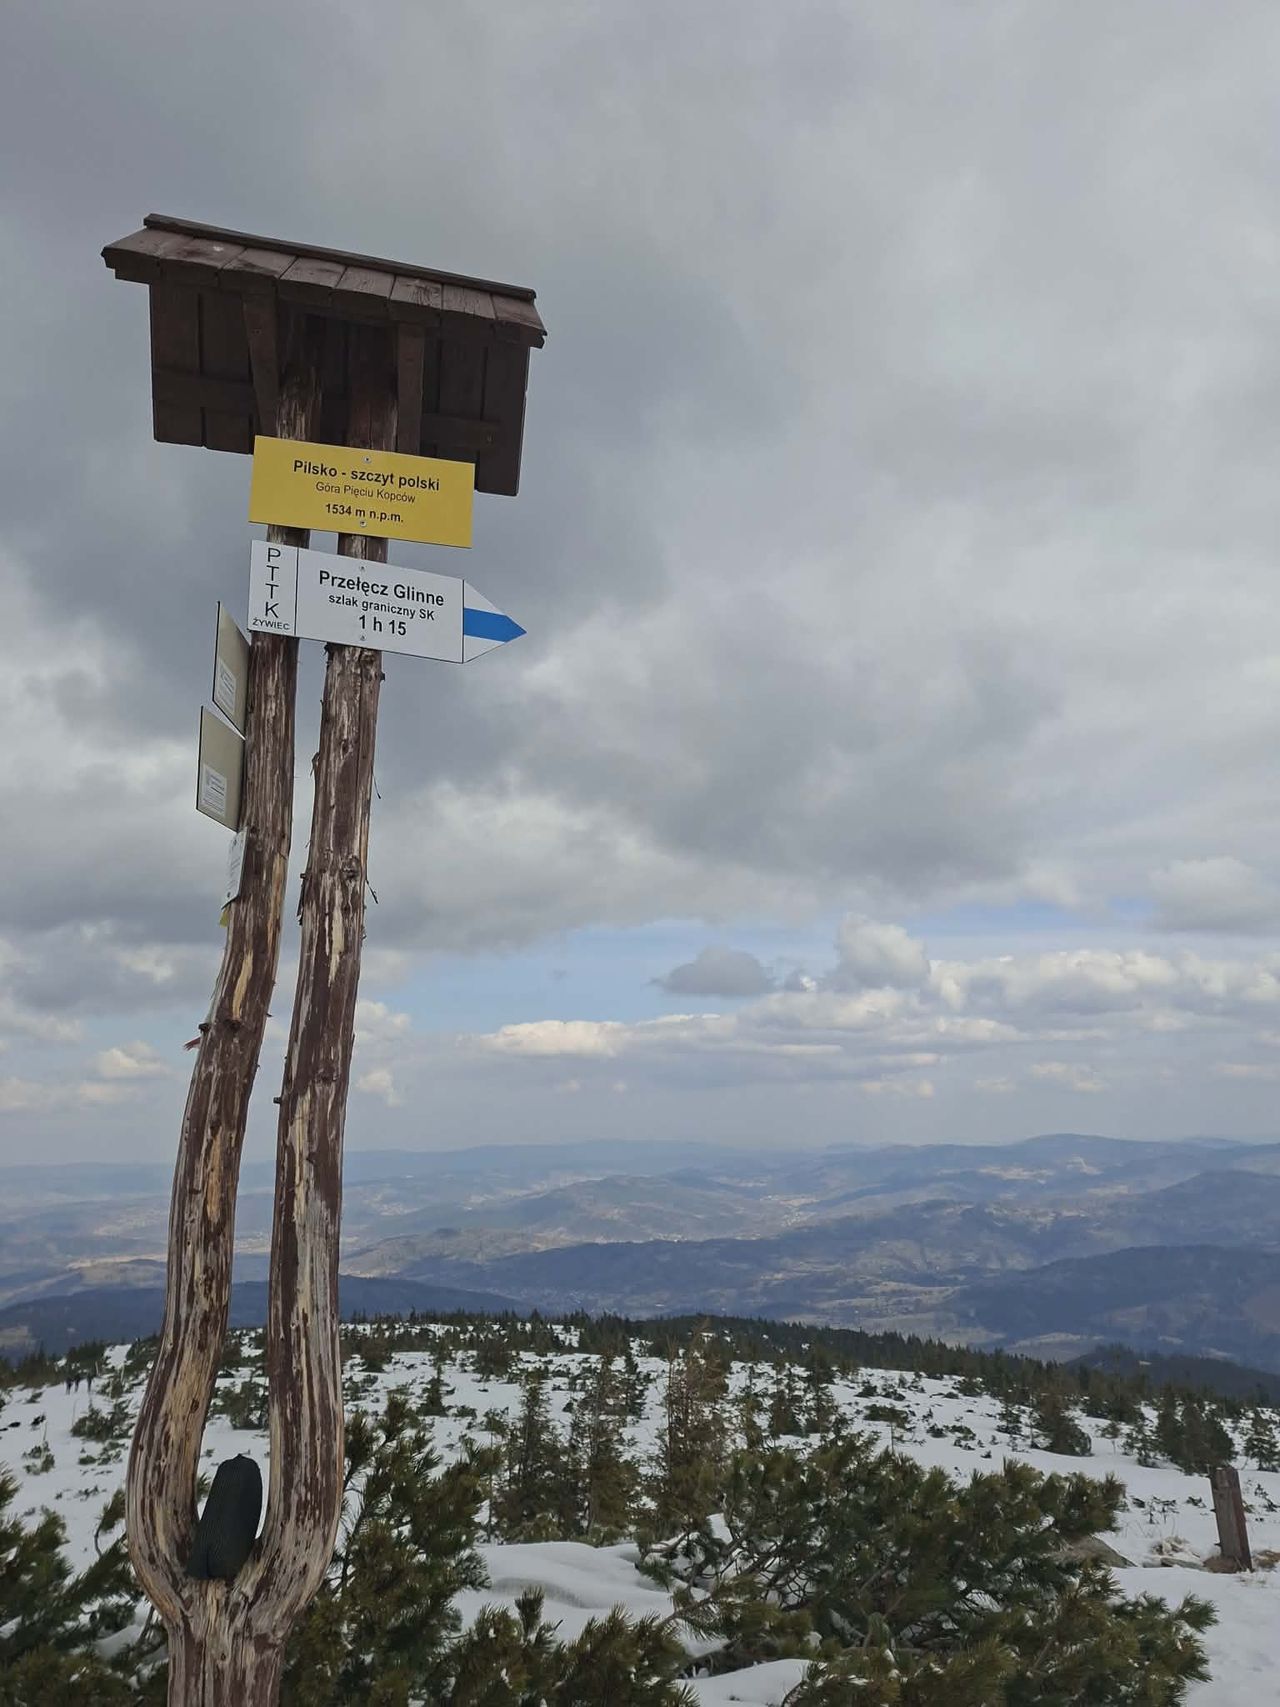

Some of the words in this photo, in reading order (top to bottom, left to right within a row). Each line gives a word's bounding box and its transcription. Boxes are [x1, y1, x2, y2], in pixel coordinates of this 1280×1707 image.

[294, 460, 337, 477] Pilsko
[351, 470, 394, 485] szczyt
[399, 476, 439, 491] polski
[316, 481, 340, 495] Góra
[344, 485, 373, 500] Pięciu
[377, 489, 415, 503] Kopców
[326, 504, 351, 516] 1534
[356, 509, 365, 517] m
[370, 510, 403, 523] n.p.m.
[319, 570, 388, 596] Przełęcz
[394, 584, 444, 606] Glinne
[329, 594, 358, 608] szlak
[362, 600, 416, 620] graniczny
[419, 608, 435, 620] SK
[359, 615, 366, 629] 1
[373, 617, 382, 632] h
[389, 620, 406, 635] 15
